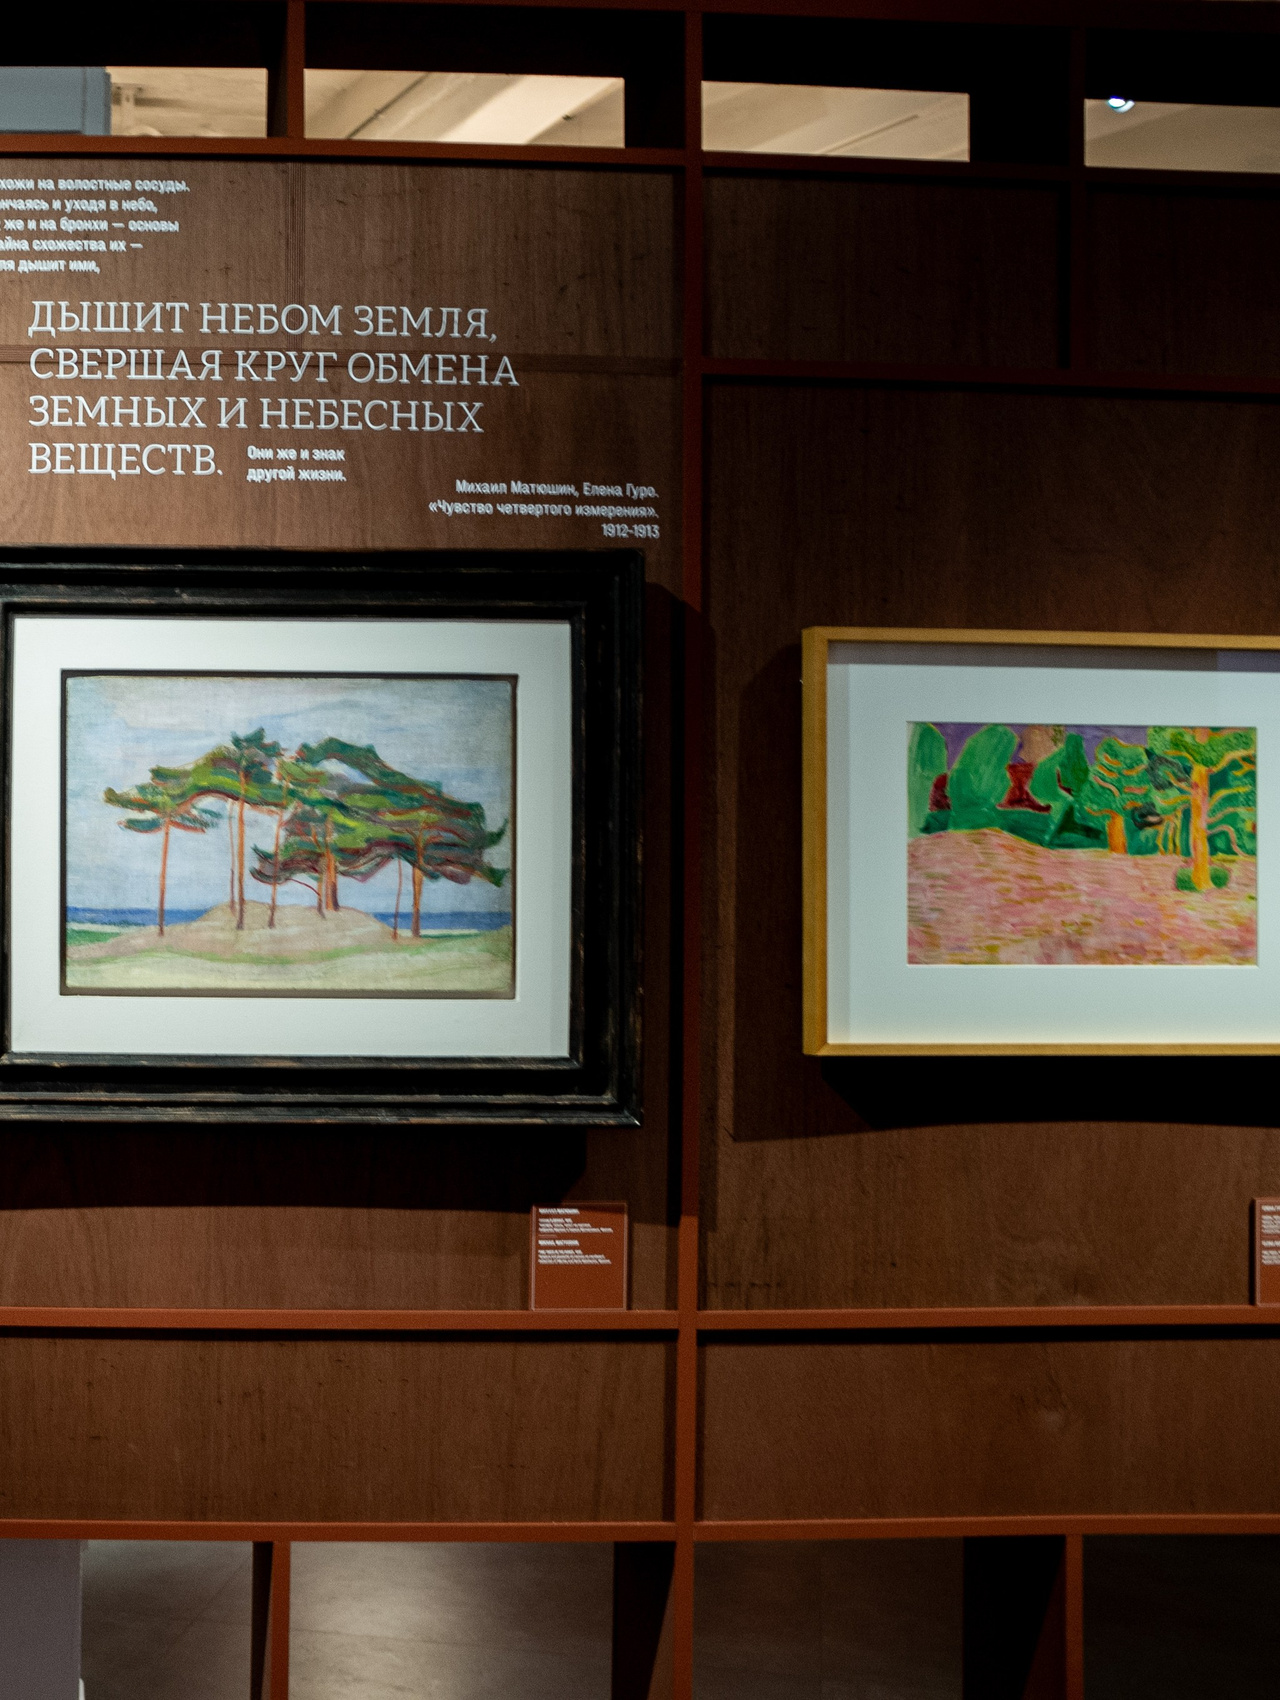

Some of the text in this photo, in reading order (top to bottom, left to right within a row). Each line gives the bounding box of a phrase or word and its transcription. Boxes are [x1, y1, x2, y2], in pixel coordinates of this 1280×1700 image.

[37, 179, 56, 190] на
[134, 180, 191, 194] сосуды.
[52, 199, 62, 210] и
[63, 200, 107, 213] уходя
[109, 200, 119, 211] в
[121, 197, 158, 213] небо,
[3, 220, 25, 230] же
[27, 220, 37, 230] и
[39, 220, 58, 230] на
[59, 216, 109, 233] бронхи
[128, 220, 180, 232] основы
[32, 240, 108, 251] схожества
[109, 240, 127, 251] их
[17, 260, 67, 273] дышит
[68, 260, 101, 274] ими,
[27, 301, 498, 343] ДЫШИТ НЕБОМ ЗЕМЛЯ,
[29, 348, 521, 386] СВЕРШАЯ КРУГ ОБМЕНА
[28, 395, 486, 432] ЗЕМНЫХ И НЕБЕСНЫХ
[27, 443, 225, 480] ВЕЩЕСТВ.
[246, 445, 346, 461] Они же и знак
[246, 466, 347, 483] другой жизни.
[455, 479, 660, 500] Михаил Матюшин, Елена Гуро.
[428, 499, 660, 519] «Чувство четвертого измерения».
[600, 523, 660, 539] 1912-1913
